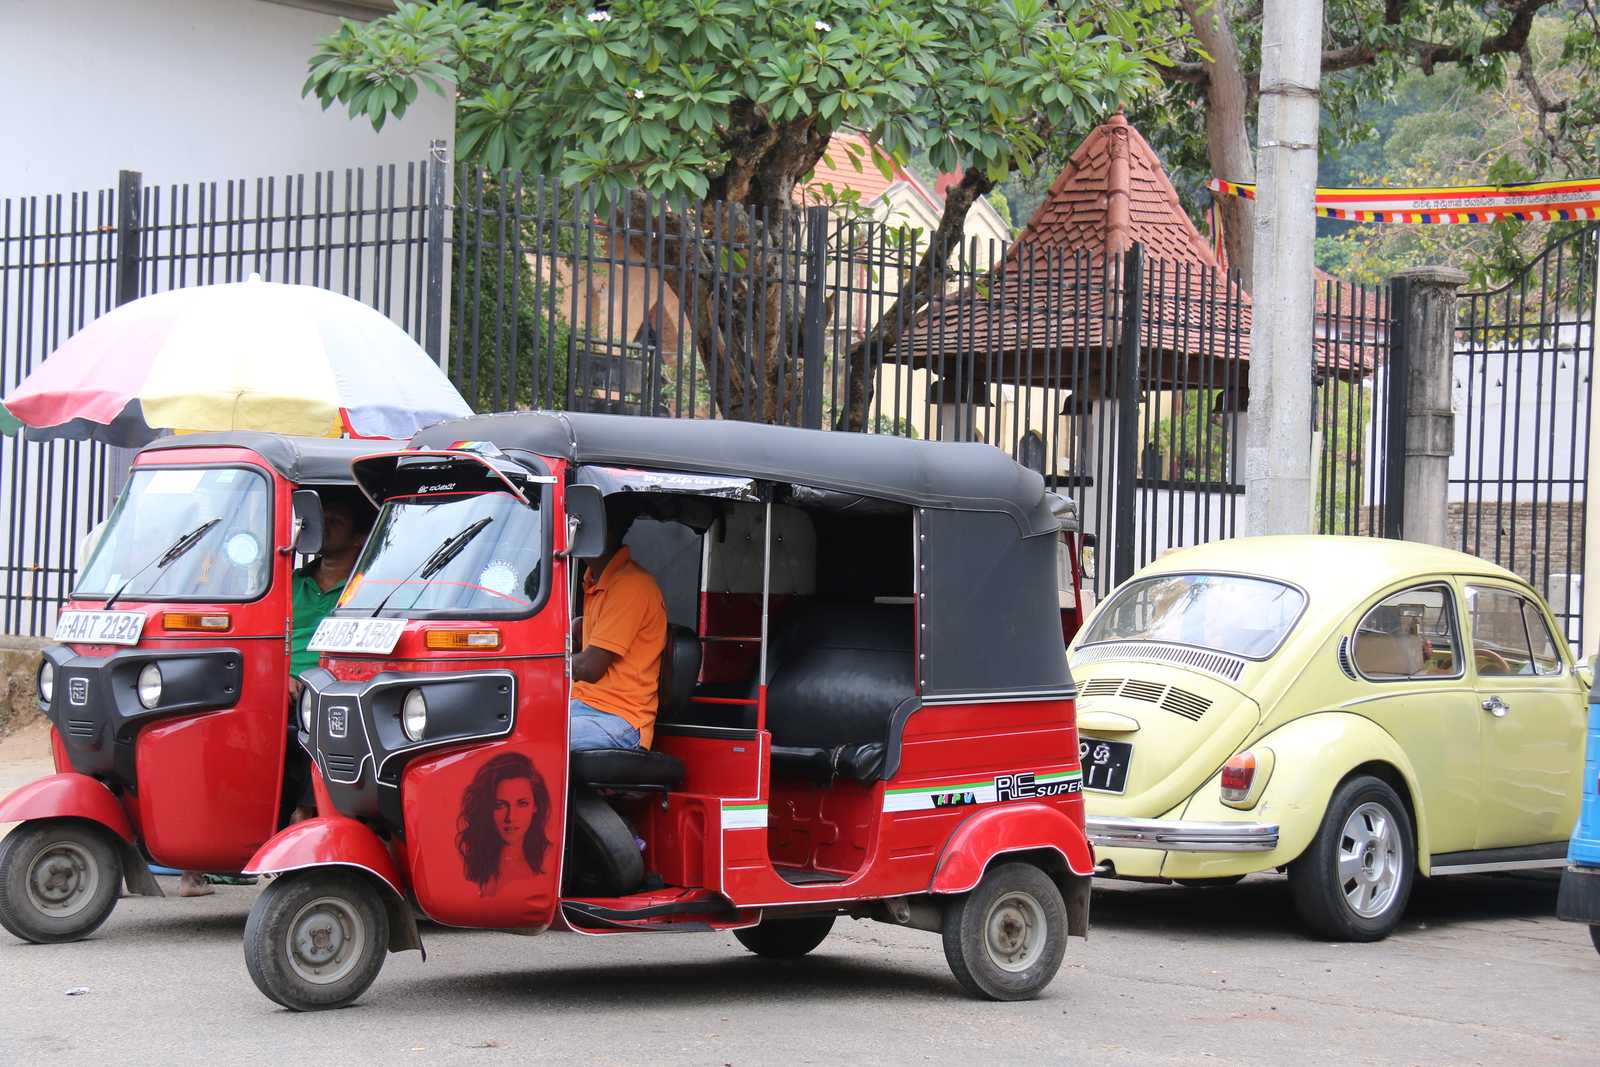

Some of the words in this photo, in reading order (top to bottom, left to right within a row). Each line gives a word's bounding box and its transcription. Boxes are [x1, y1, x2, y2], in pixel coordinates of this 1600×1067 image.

[100, 615, 140, 640] 2126
[994, 772, 1036, 802] RE
[1036, 781, 1083, 798] SUPER
